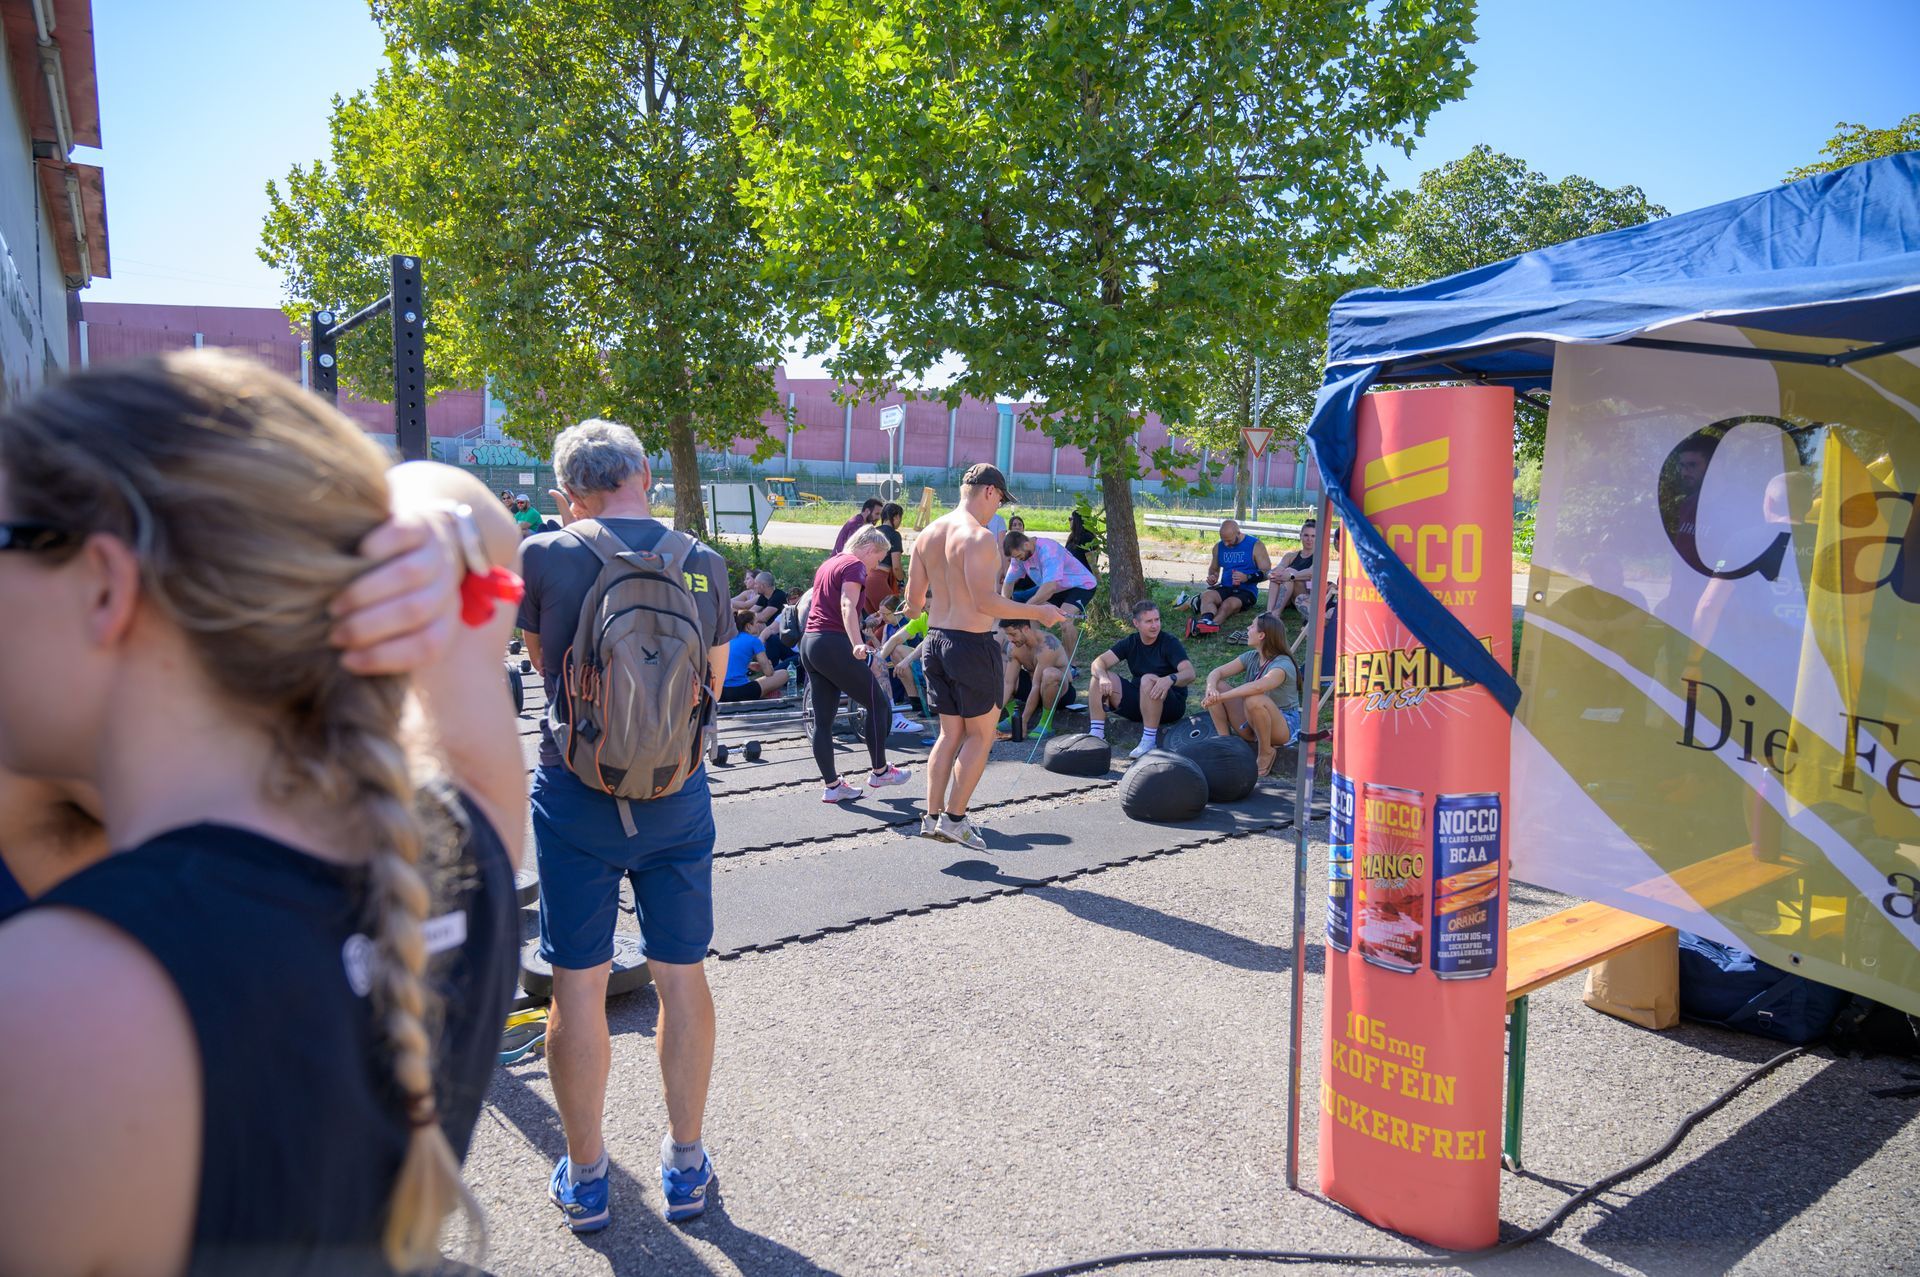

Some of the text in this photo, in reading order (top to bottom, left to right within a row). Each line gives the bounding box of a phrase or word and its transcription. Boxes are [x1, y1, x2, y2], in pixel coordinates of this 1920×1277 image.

[1344, 523, 1482, 583] NCCO
[1355, 586, 1385, 604] CARB
[1432, 589, 1477, 606] PANY
[1365, 687, 1428, 712] Del Sol
[1676, 677, 1799, 775] Die
[1365, 798, 1421, 831] NOCCO
[1438, 808, 1498, 835] NOCCO
[1470, 834, 1496, 842] COMPANY
[1361, 853, 1425, 880] MANGO
[1449, 846, 1488, 863] BCAA
[1448, 909, 1487, 932] ORANGE
[1440, 933, 1470, 942] KOFFEIN
[1332, 1038, 1457, 1106] KOFFEIN
